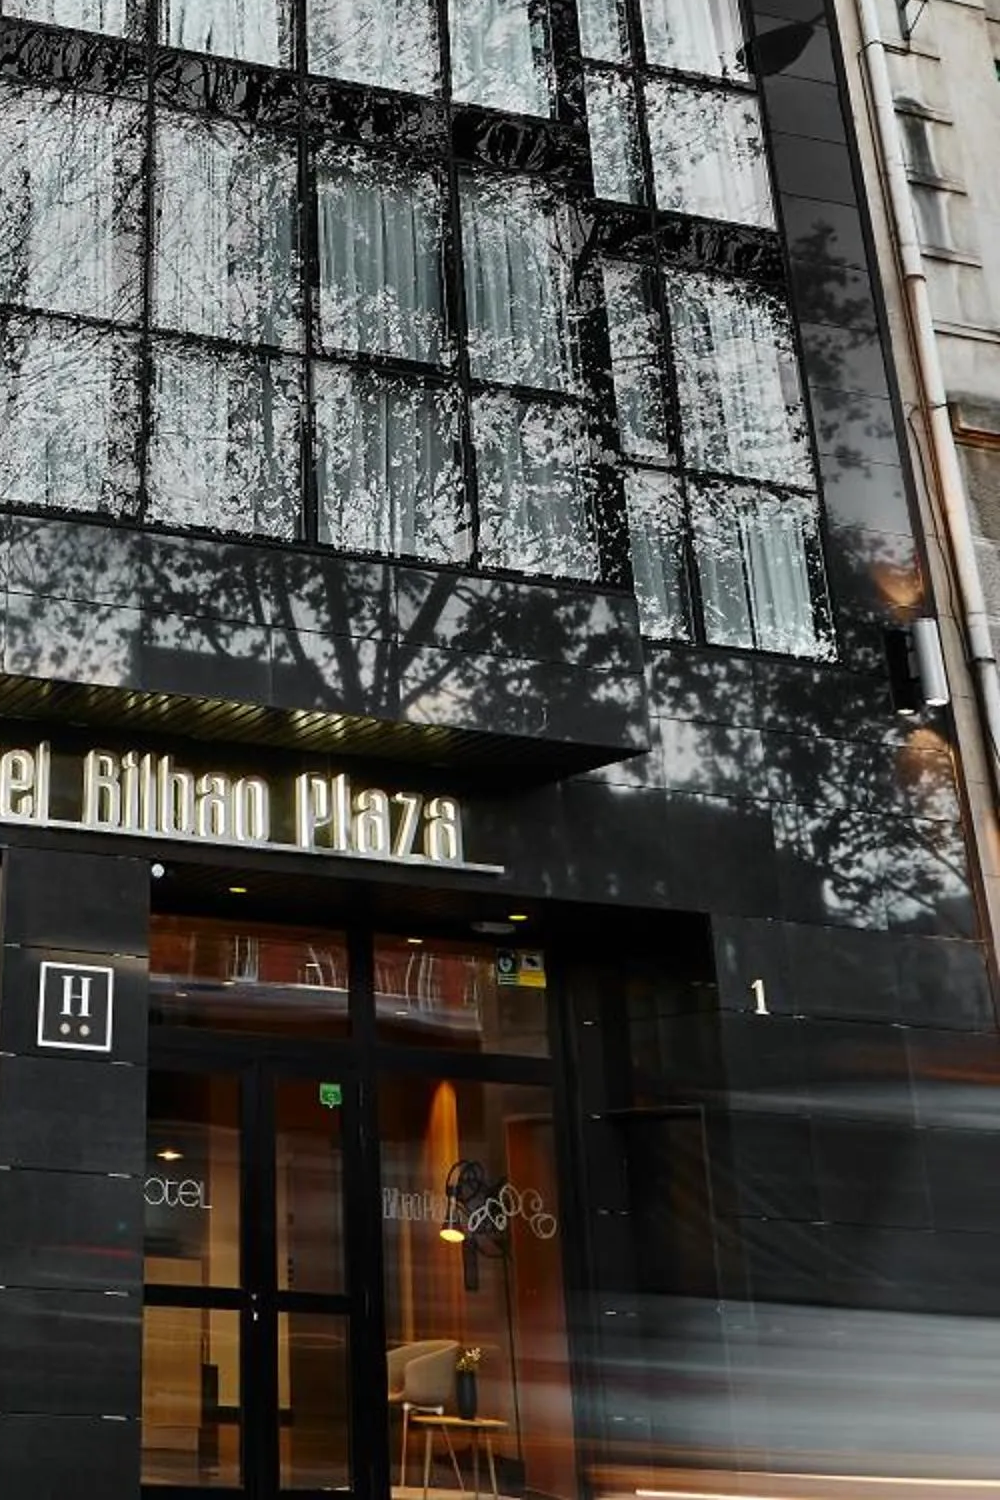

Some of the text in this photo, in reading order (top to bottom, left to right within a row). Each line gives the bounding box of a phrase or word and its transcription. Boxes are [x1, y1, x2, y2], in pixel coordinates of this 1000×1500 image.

[82, 749, 270, 841] Bilbao
[295, 772, 464, 863] Plaza
[59, 975, 94, 1017] H
[751, 979, 770, 1015] 1
